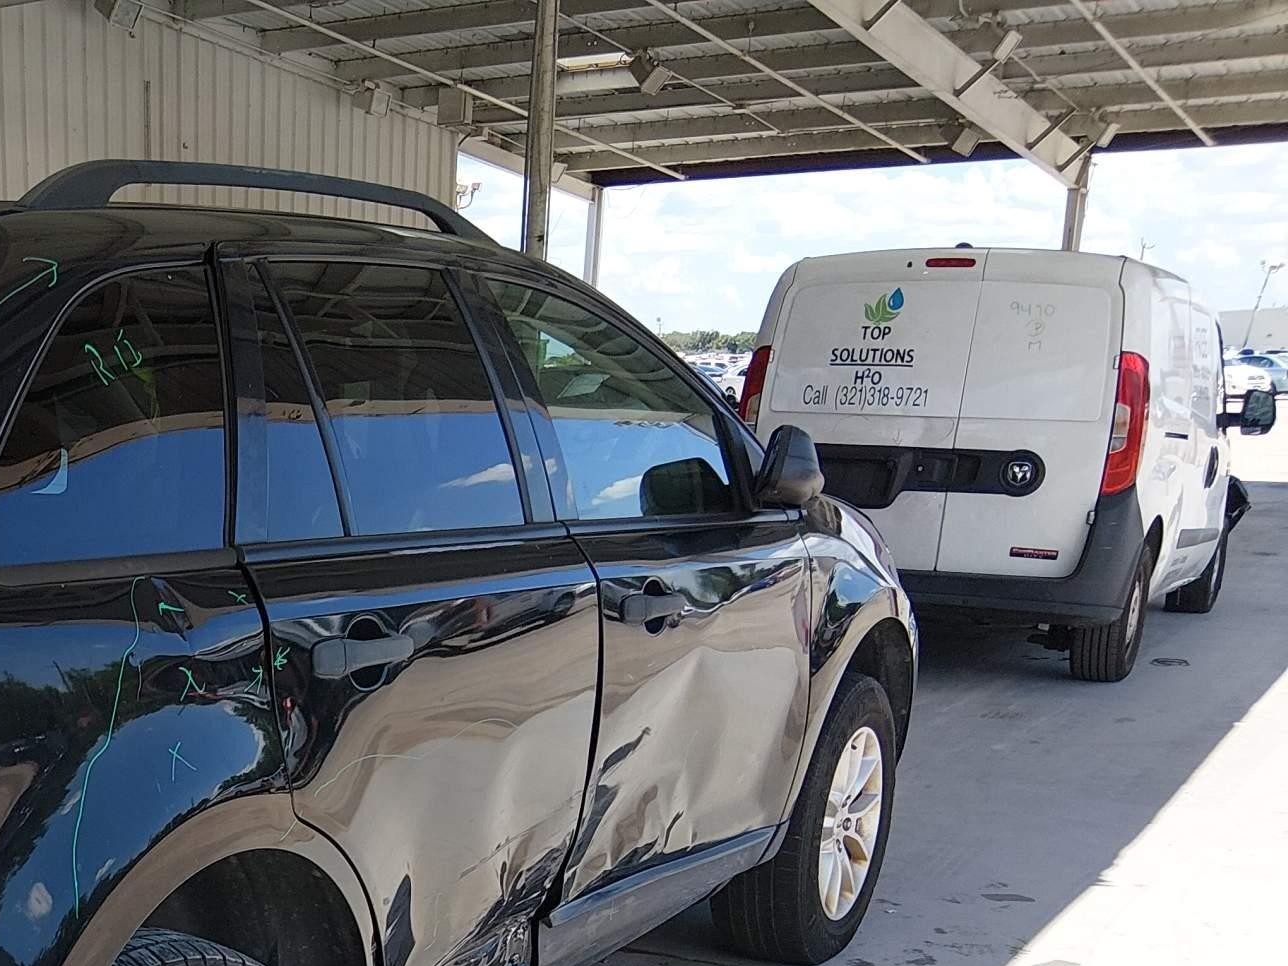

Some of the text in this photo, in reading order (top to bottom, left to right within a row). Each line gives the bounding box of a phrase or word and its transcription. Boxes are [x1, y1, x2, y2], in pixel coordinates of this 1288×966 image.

[861, 326, 892, 341] TOP
[830, 347, 914, 364] SOLUTIONS
[802, 384, 929, 411] Call (321)318-9721
